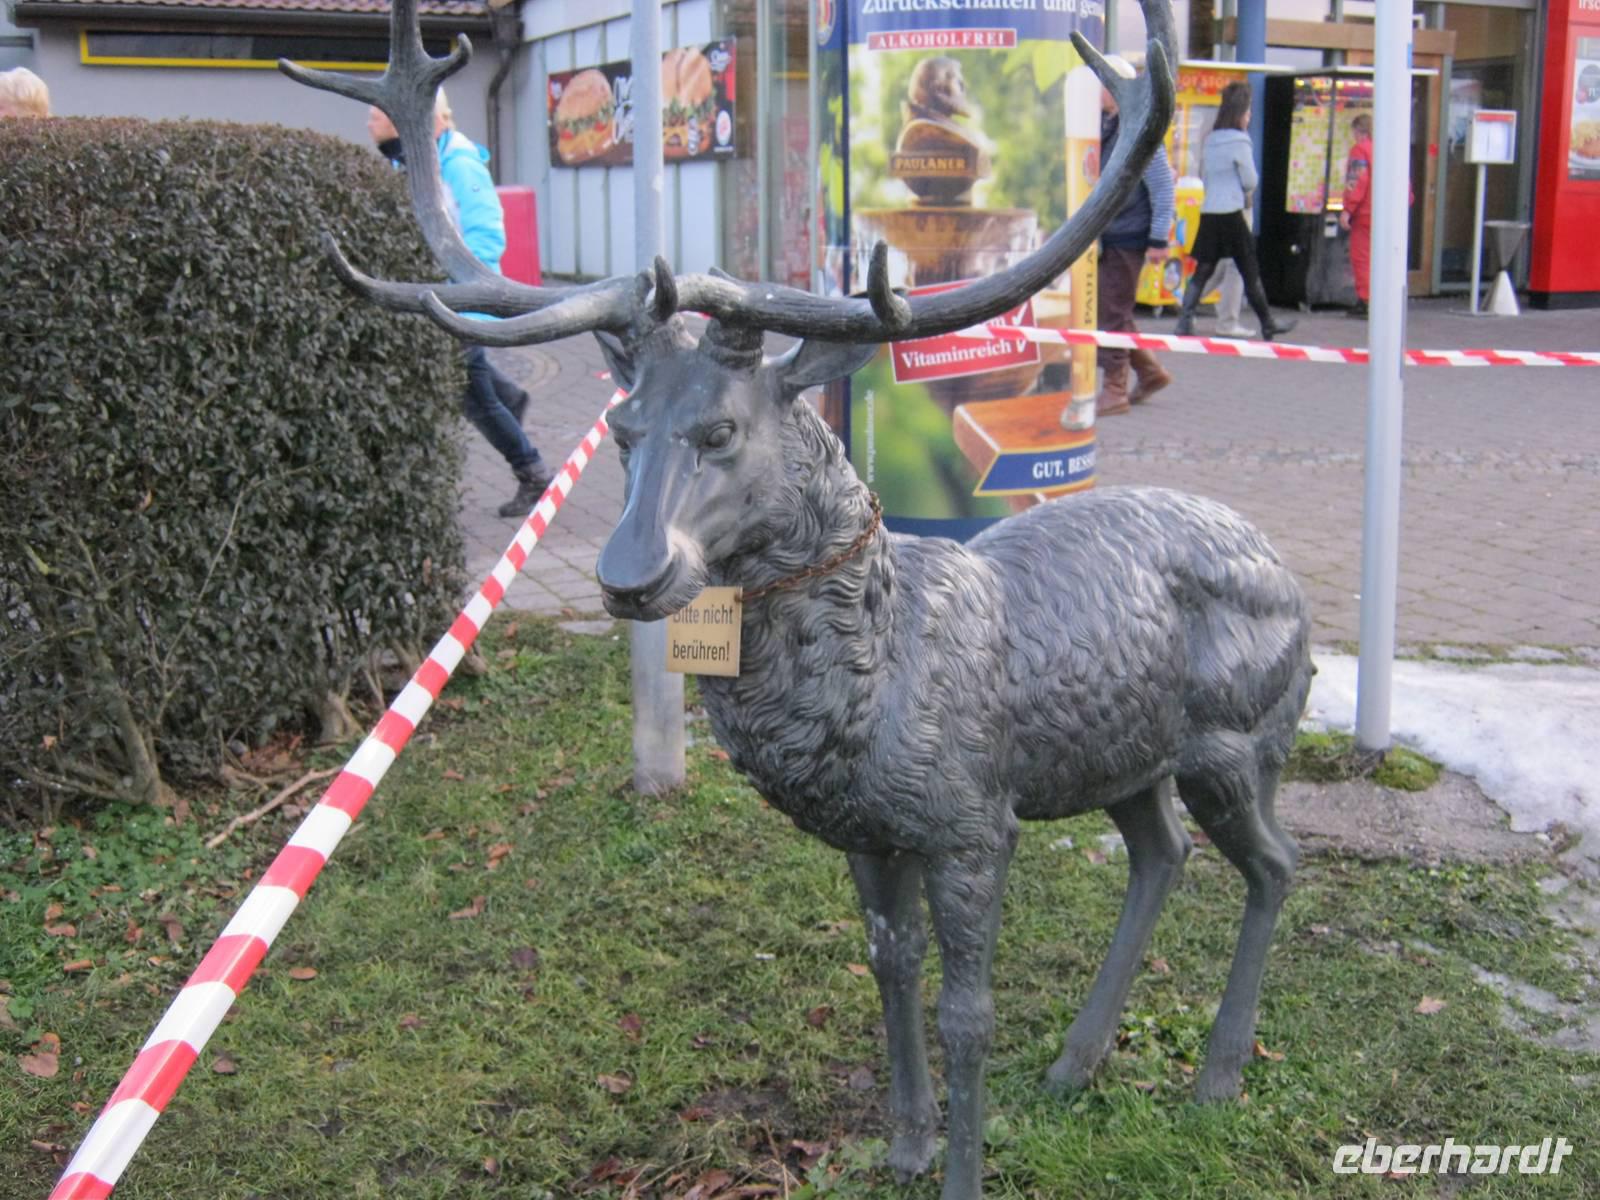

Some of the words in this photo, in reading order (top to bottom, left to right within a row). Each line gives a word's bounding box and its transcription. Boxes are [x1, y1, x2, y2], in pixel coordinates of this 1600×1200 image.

[878, 31, 1005, 49] ALKOHOLFREI
[896, 157, 966, 170] PAULANER
[901, 341, 1012, 369] Vitaminreich
[1033, 459, 1065, 480] GUT,
[703, 603, 734, 624] nicht
[673, 639, 731, 662] berühren!
